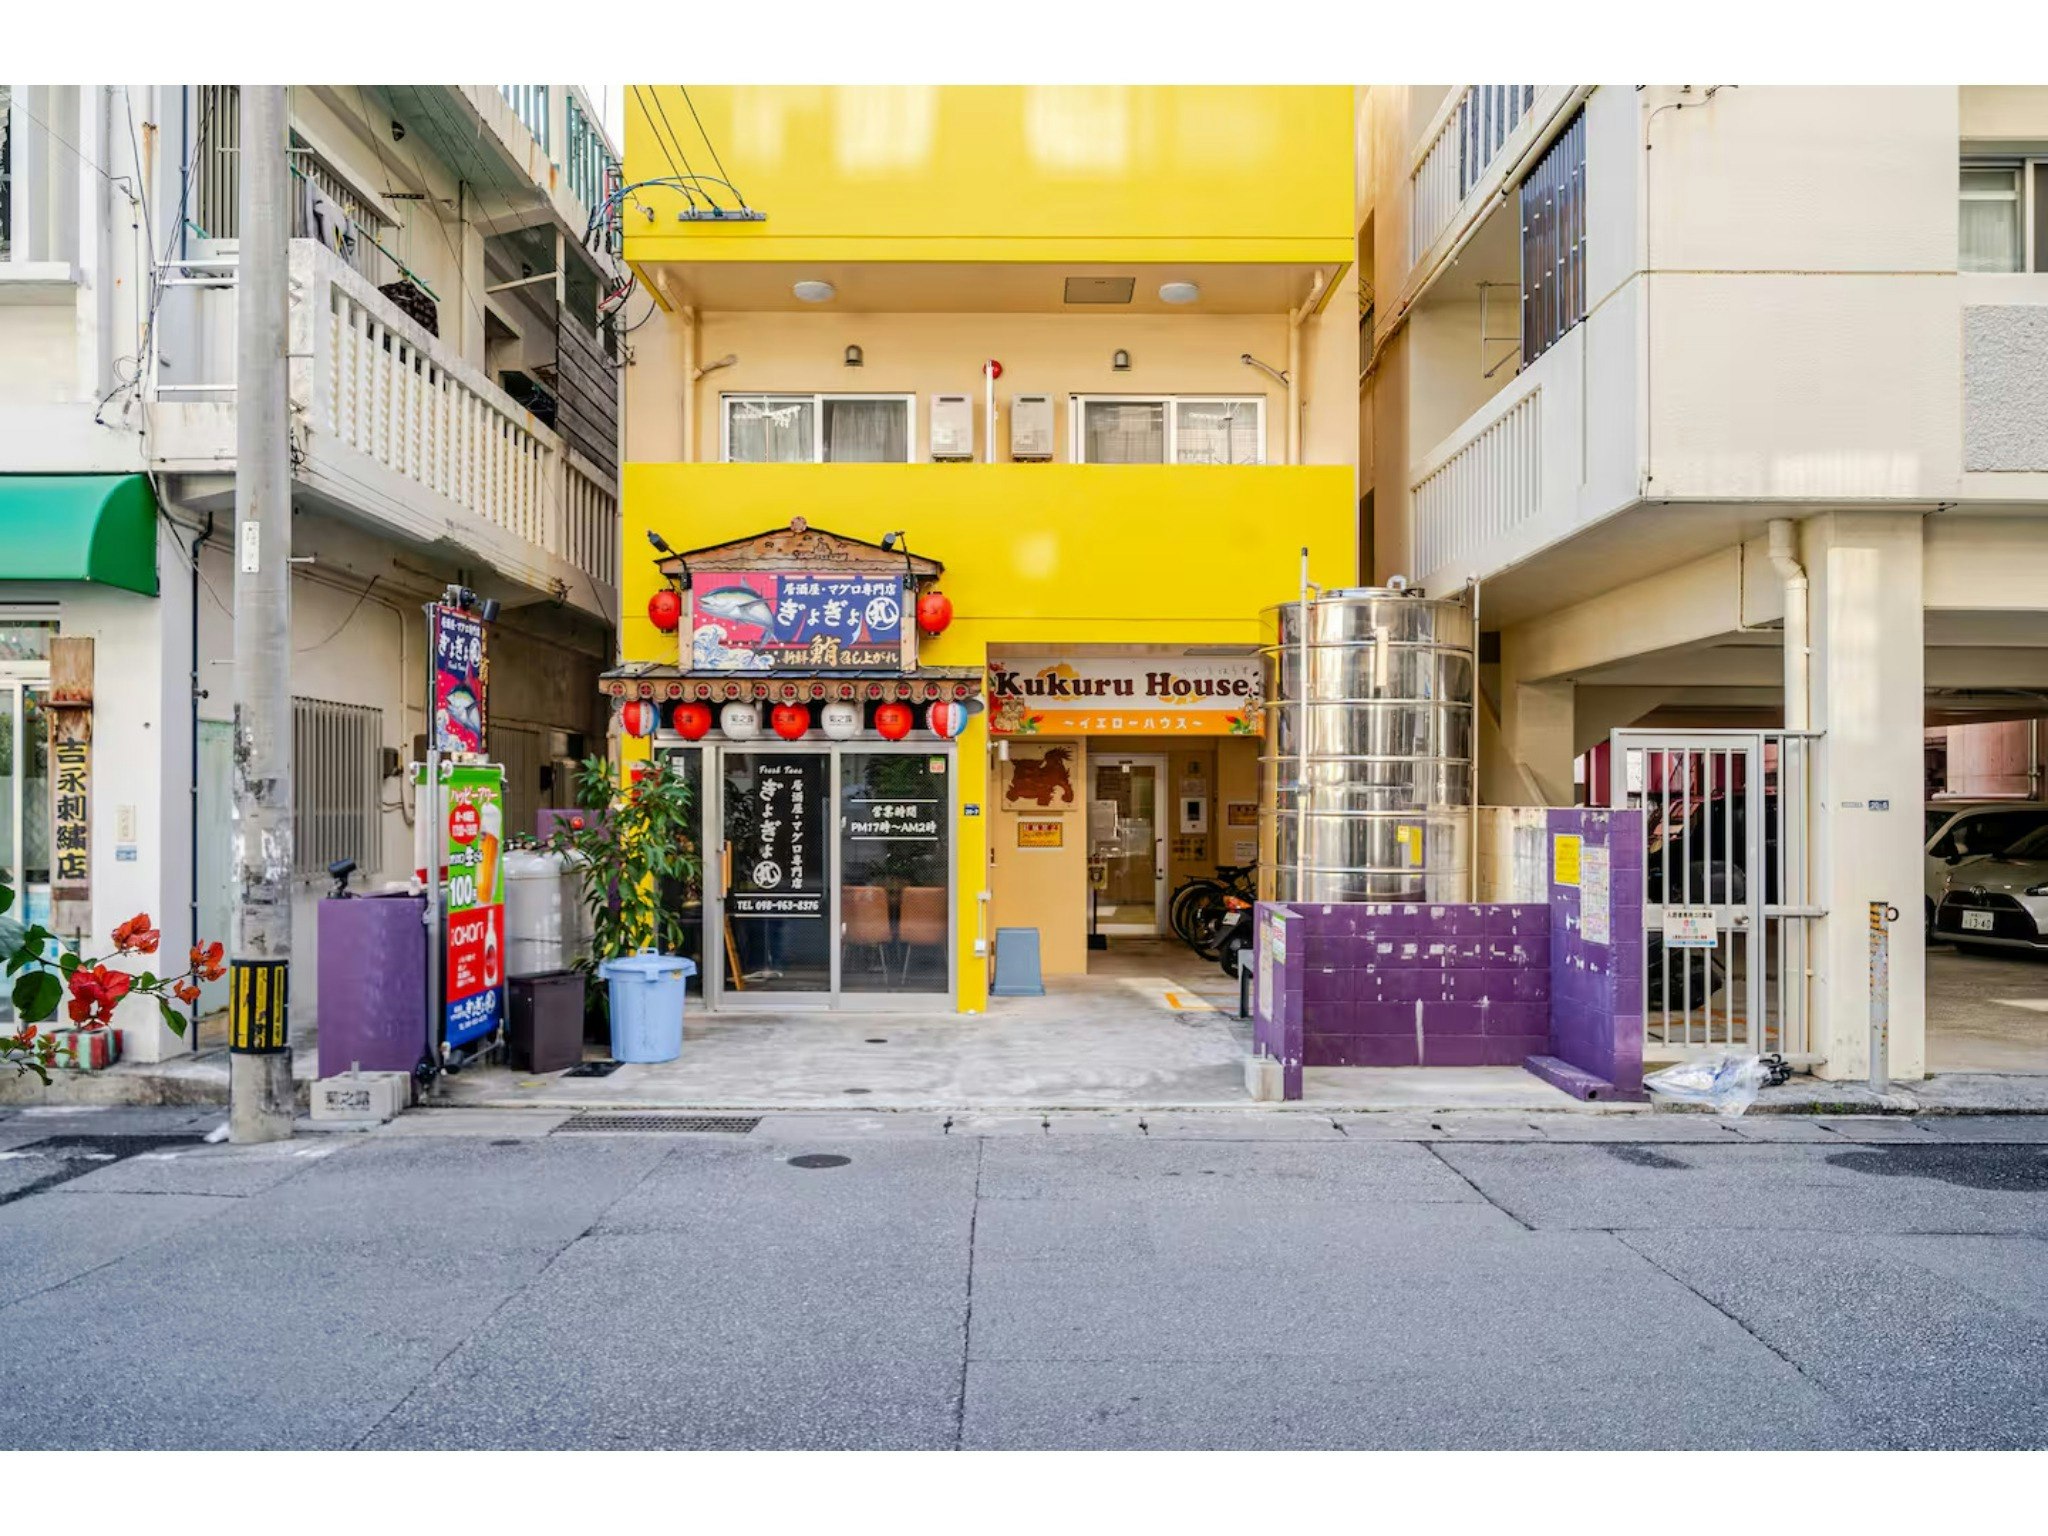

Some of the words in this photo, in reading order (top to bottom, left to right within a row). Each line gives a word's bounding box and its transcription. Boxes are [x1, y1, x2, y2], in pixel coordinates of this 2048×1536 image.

[783, 582, 897, 596] 居酒屋・マグロ専門店
[996, 672, 1134, 696] Kukuru
[56, 737, 87, 880] 吉永刺繍店
[872, 805, 917, 818] 営業時間
[737, 901, 753, 910] TEL
